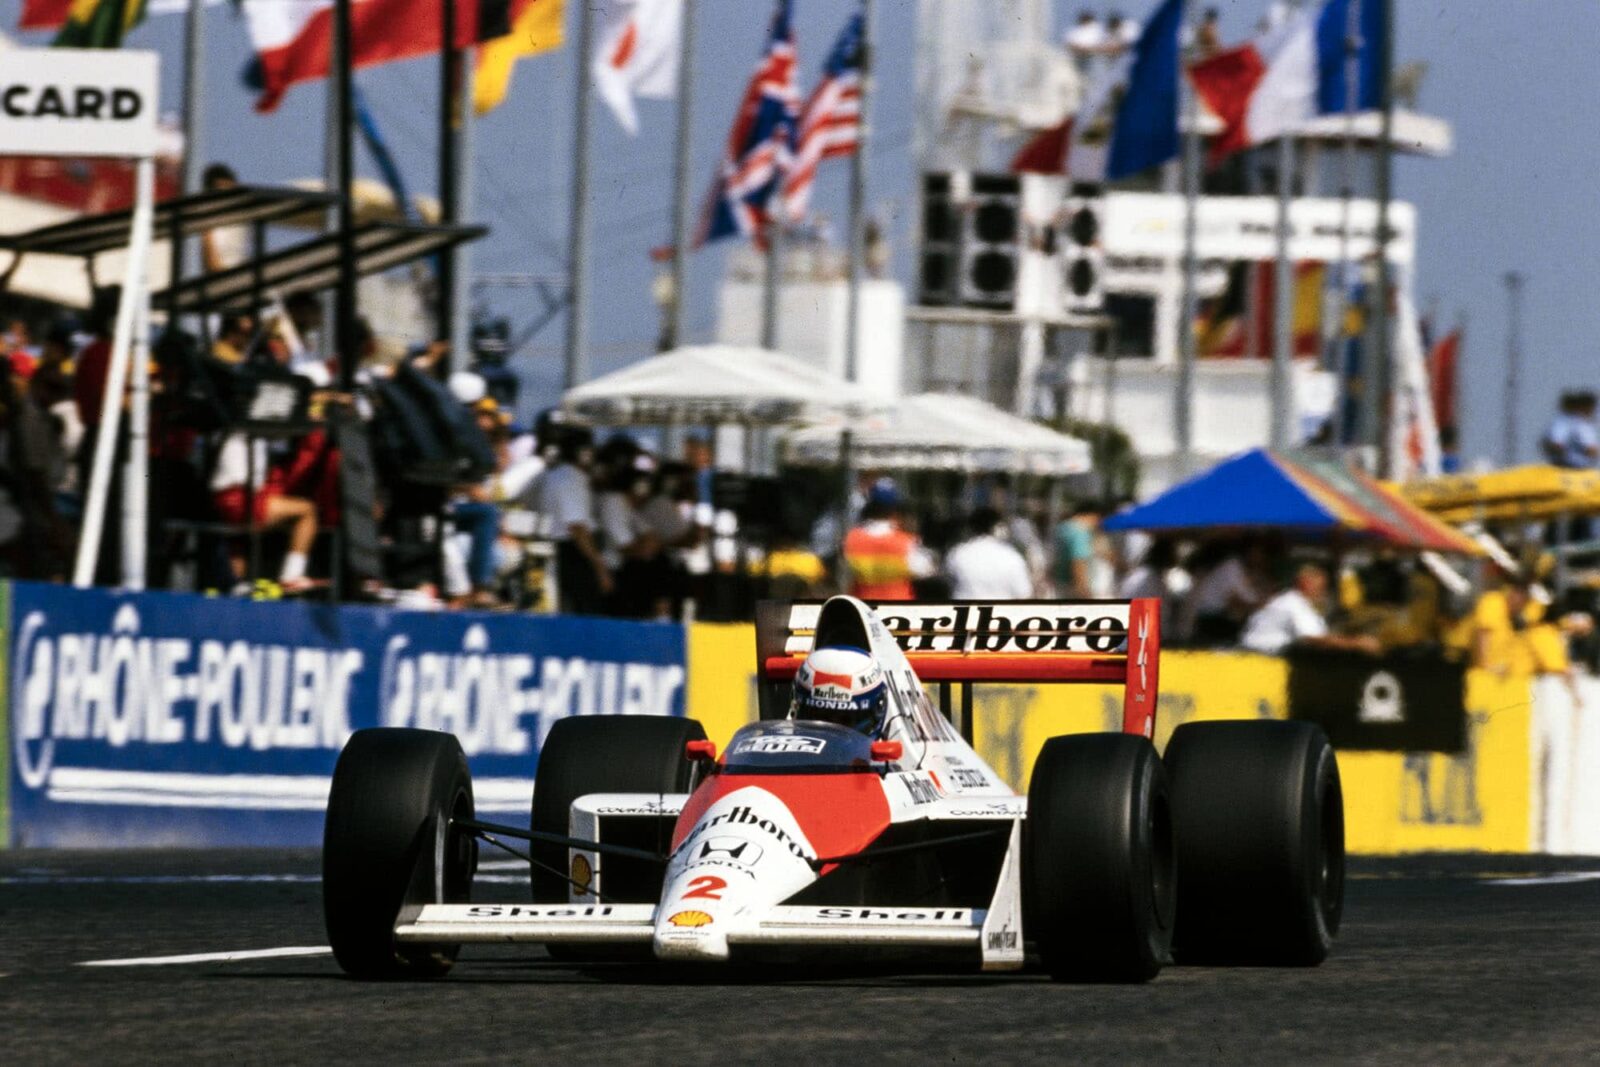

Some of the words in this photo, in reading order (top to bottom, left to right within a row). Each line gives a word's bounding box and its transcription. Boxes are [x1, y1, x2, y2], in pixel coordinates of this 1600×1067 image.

[0, 84, 142, 120] CARD
[872, 606, 1124, 652] arlboro
[814, 686, 850, 699] Marlboro
[806, 699, 859, 710] HONDA
[681, 875, 728, 900] 2
[466, 907, 613, 917] Shell
[816, 908, 964, 920] Shell
